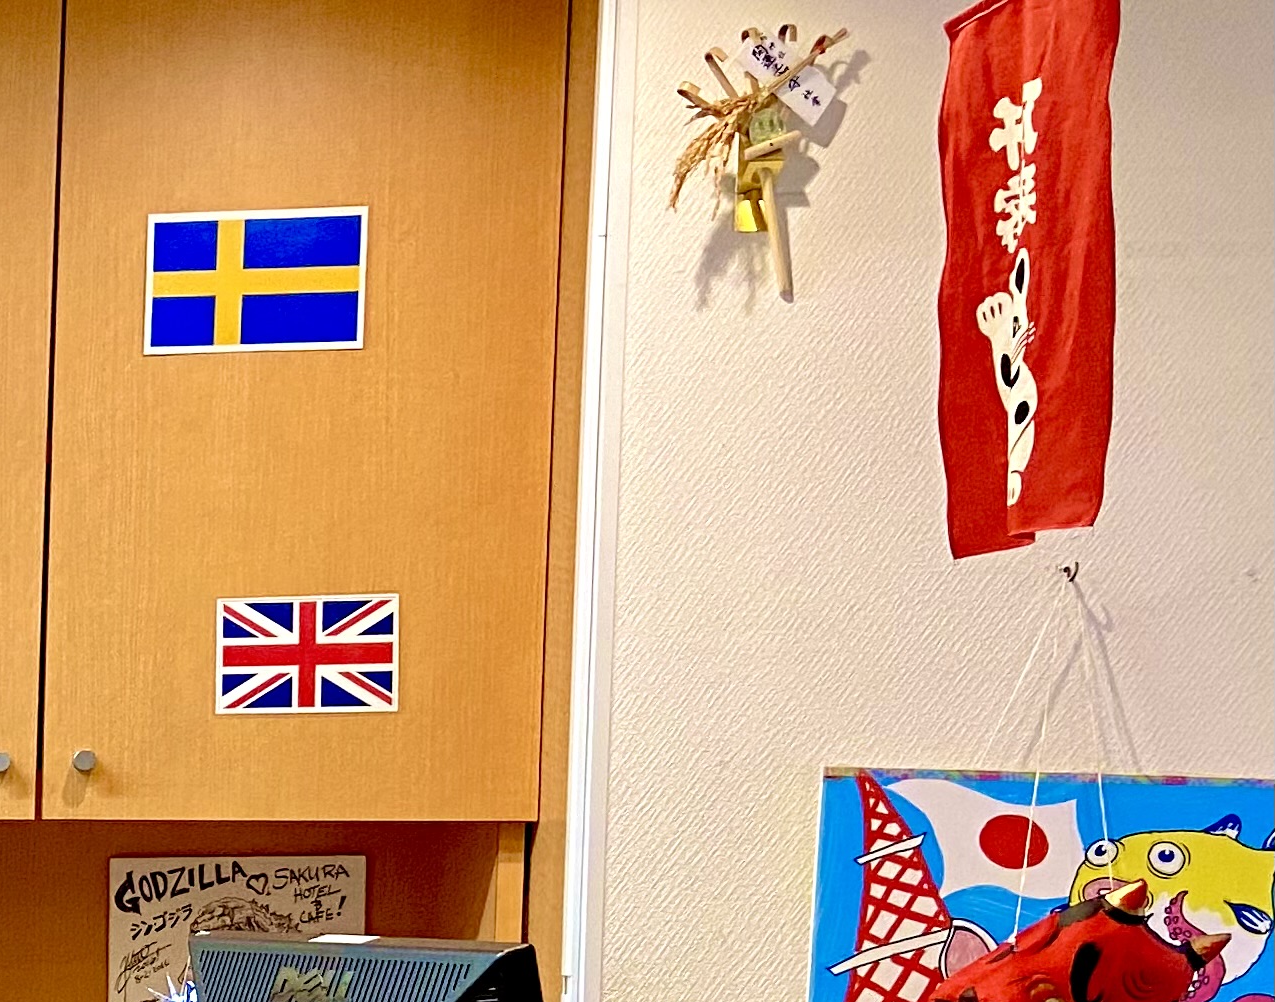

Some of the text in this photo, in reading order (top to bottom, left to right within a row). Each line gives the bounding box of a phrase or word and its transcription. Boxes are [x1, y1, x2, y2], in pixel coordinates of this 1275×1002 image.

[114, 861, 247, 915] GODZILLA
[273, 864, 350, 890] SAKURA
[293, 885, 341, 903] HOTEL
